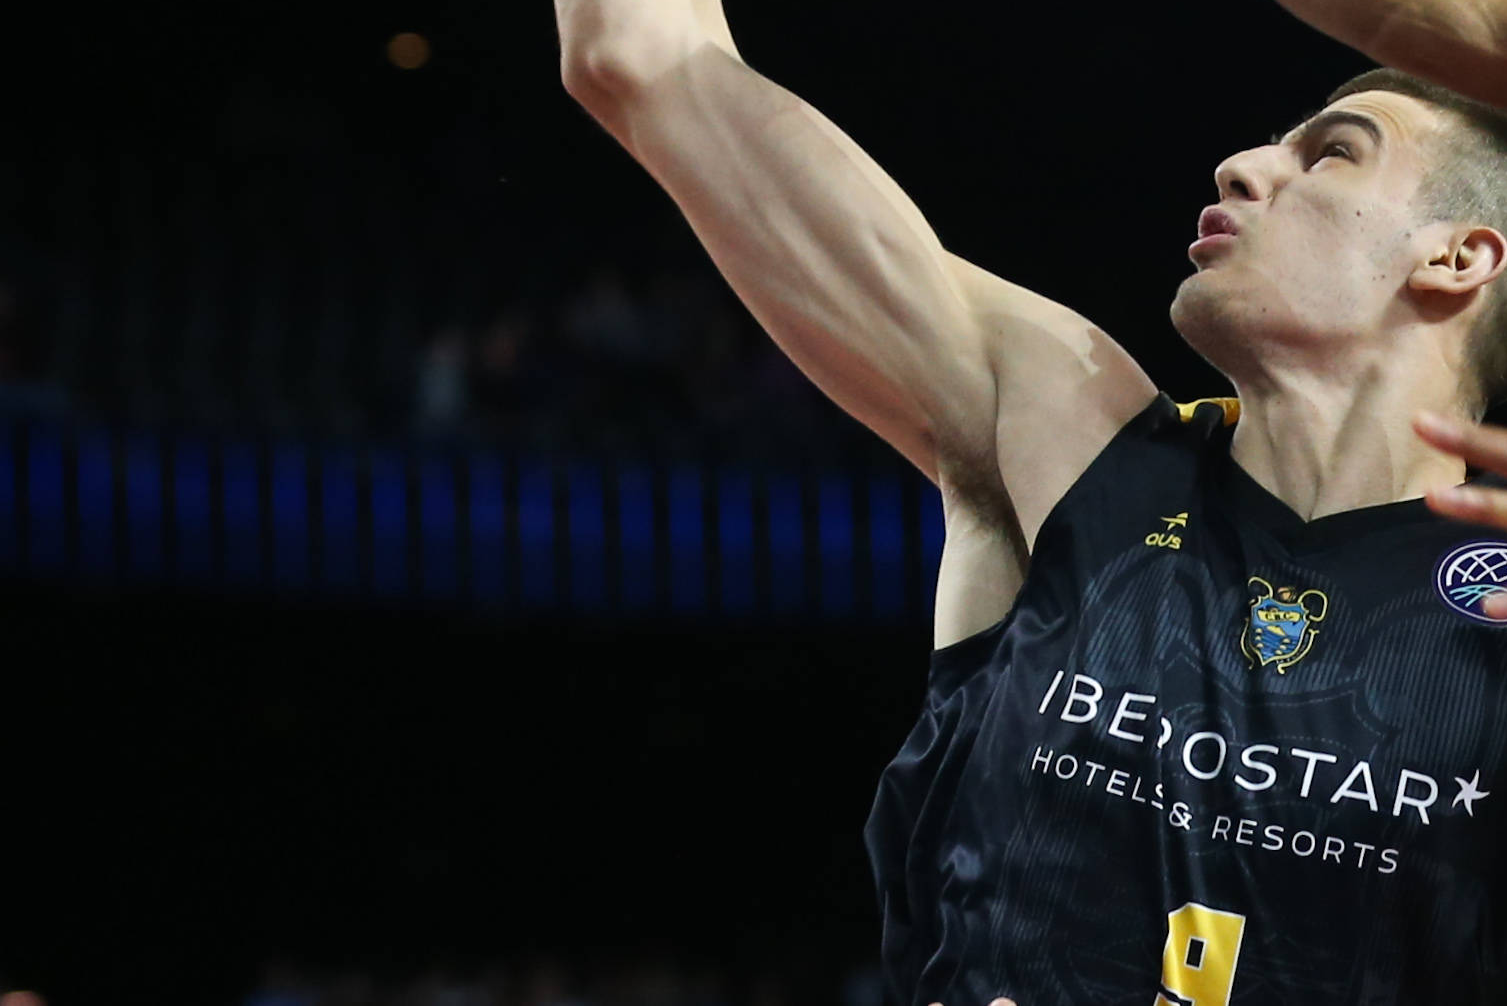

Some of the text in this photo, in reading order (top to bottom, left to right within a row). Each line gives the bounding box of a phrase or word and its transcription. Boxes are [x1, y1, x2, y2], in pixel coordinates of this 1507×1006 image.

[1169, 801, 1193, 831] &
[1211, 815, 1400, 874] RESORTS
[1153, 901, 1247, 1006] 9
